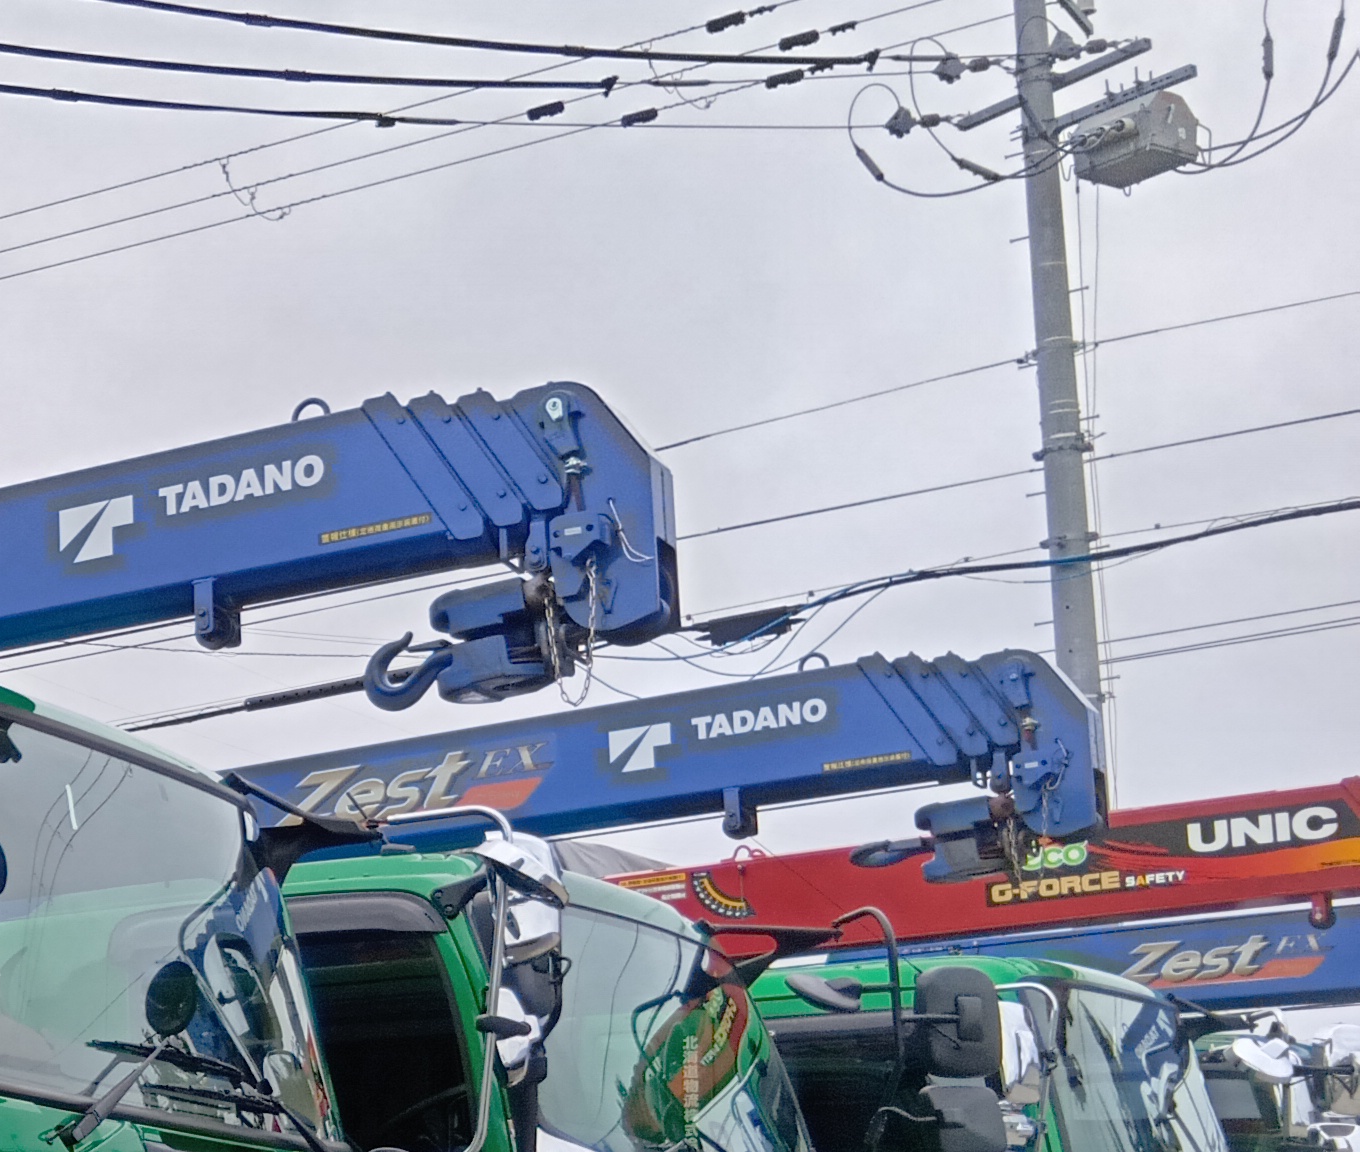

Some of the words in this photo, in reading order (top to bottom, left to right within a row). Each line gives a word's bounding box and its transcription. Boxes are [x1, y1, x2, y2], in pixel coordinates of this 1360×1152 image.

[158, 454, 325, 516] TADANO
[690, 697, 828, 740] TADANO
[275, 750, 469, 827] Zest
[474, 743, 553, 779] EX
[1187, 806, 1339, 853] UNIC
[991, 870, 1120, 904] G-FORCE
[1125, 870, 1186, 888] SAFETY
[1121, 934, 1270, 983] Zest
